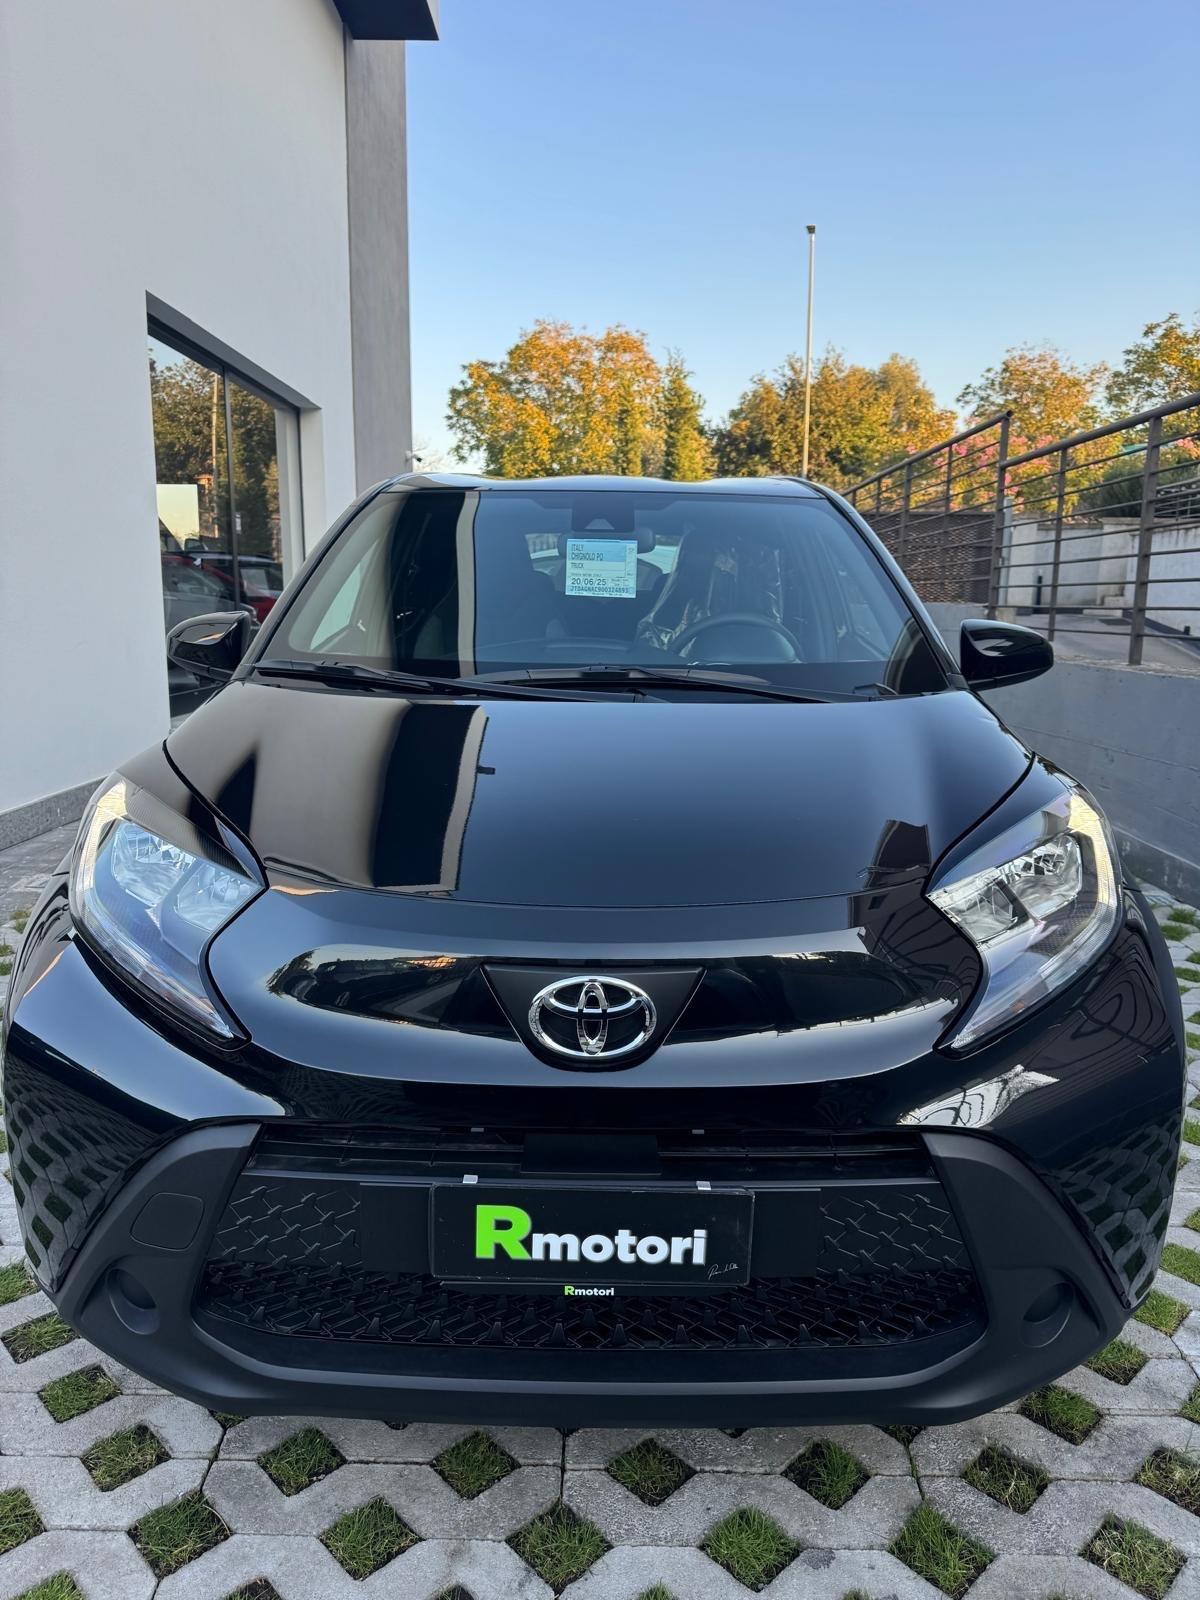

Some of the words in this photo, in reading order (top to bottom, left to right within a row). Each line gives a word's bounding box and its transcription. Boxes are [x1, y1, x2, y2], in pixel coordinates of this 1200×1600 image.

[571, 578, 606, 586] 20/06/25
[475, 1204, 707, 1265] Rmotori
[564, 1285, 615, 1297] Rmotori
